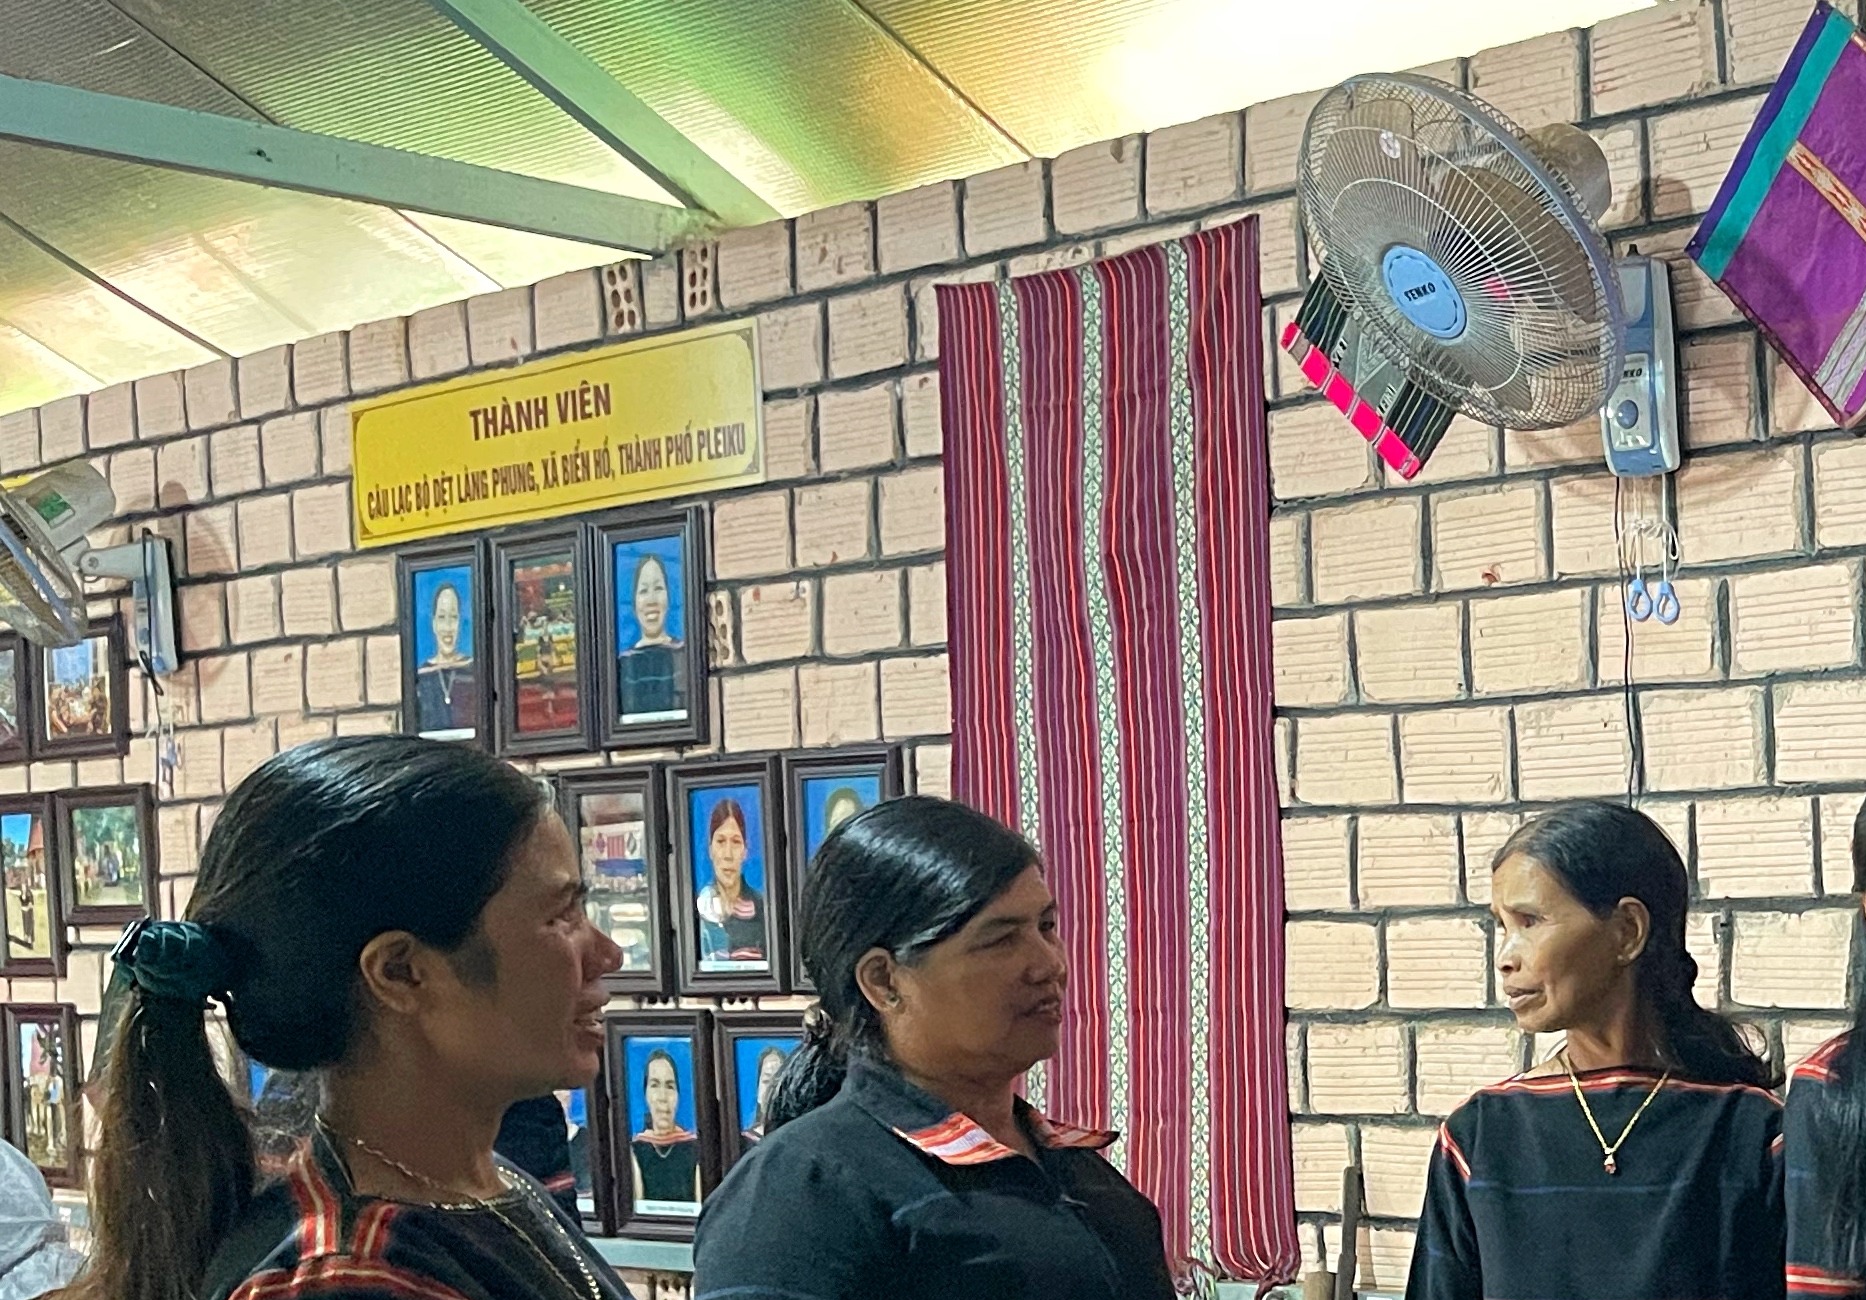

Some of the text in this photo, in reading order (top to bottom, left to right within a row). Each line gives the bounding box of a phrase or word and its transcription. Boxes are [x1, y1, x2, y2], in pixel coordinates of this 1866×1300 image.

[1403, 282, 1436, 301] SENKO
[469, 380, 611, 441] THÀNH VIÊN
[391, 484, 412, 522] LẠC
[456, 464, 489, 503] LÀNG
[492, 461, 540, 495] PHUNG,
[541, 451, 559, 490] XÃ
[618, 433, 663, 475] THÀNH
[665, 419, 693, 468] PHỐ
[697, 422, 746, 462] PLEIKU
